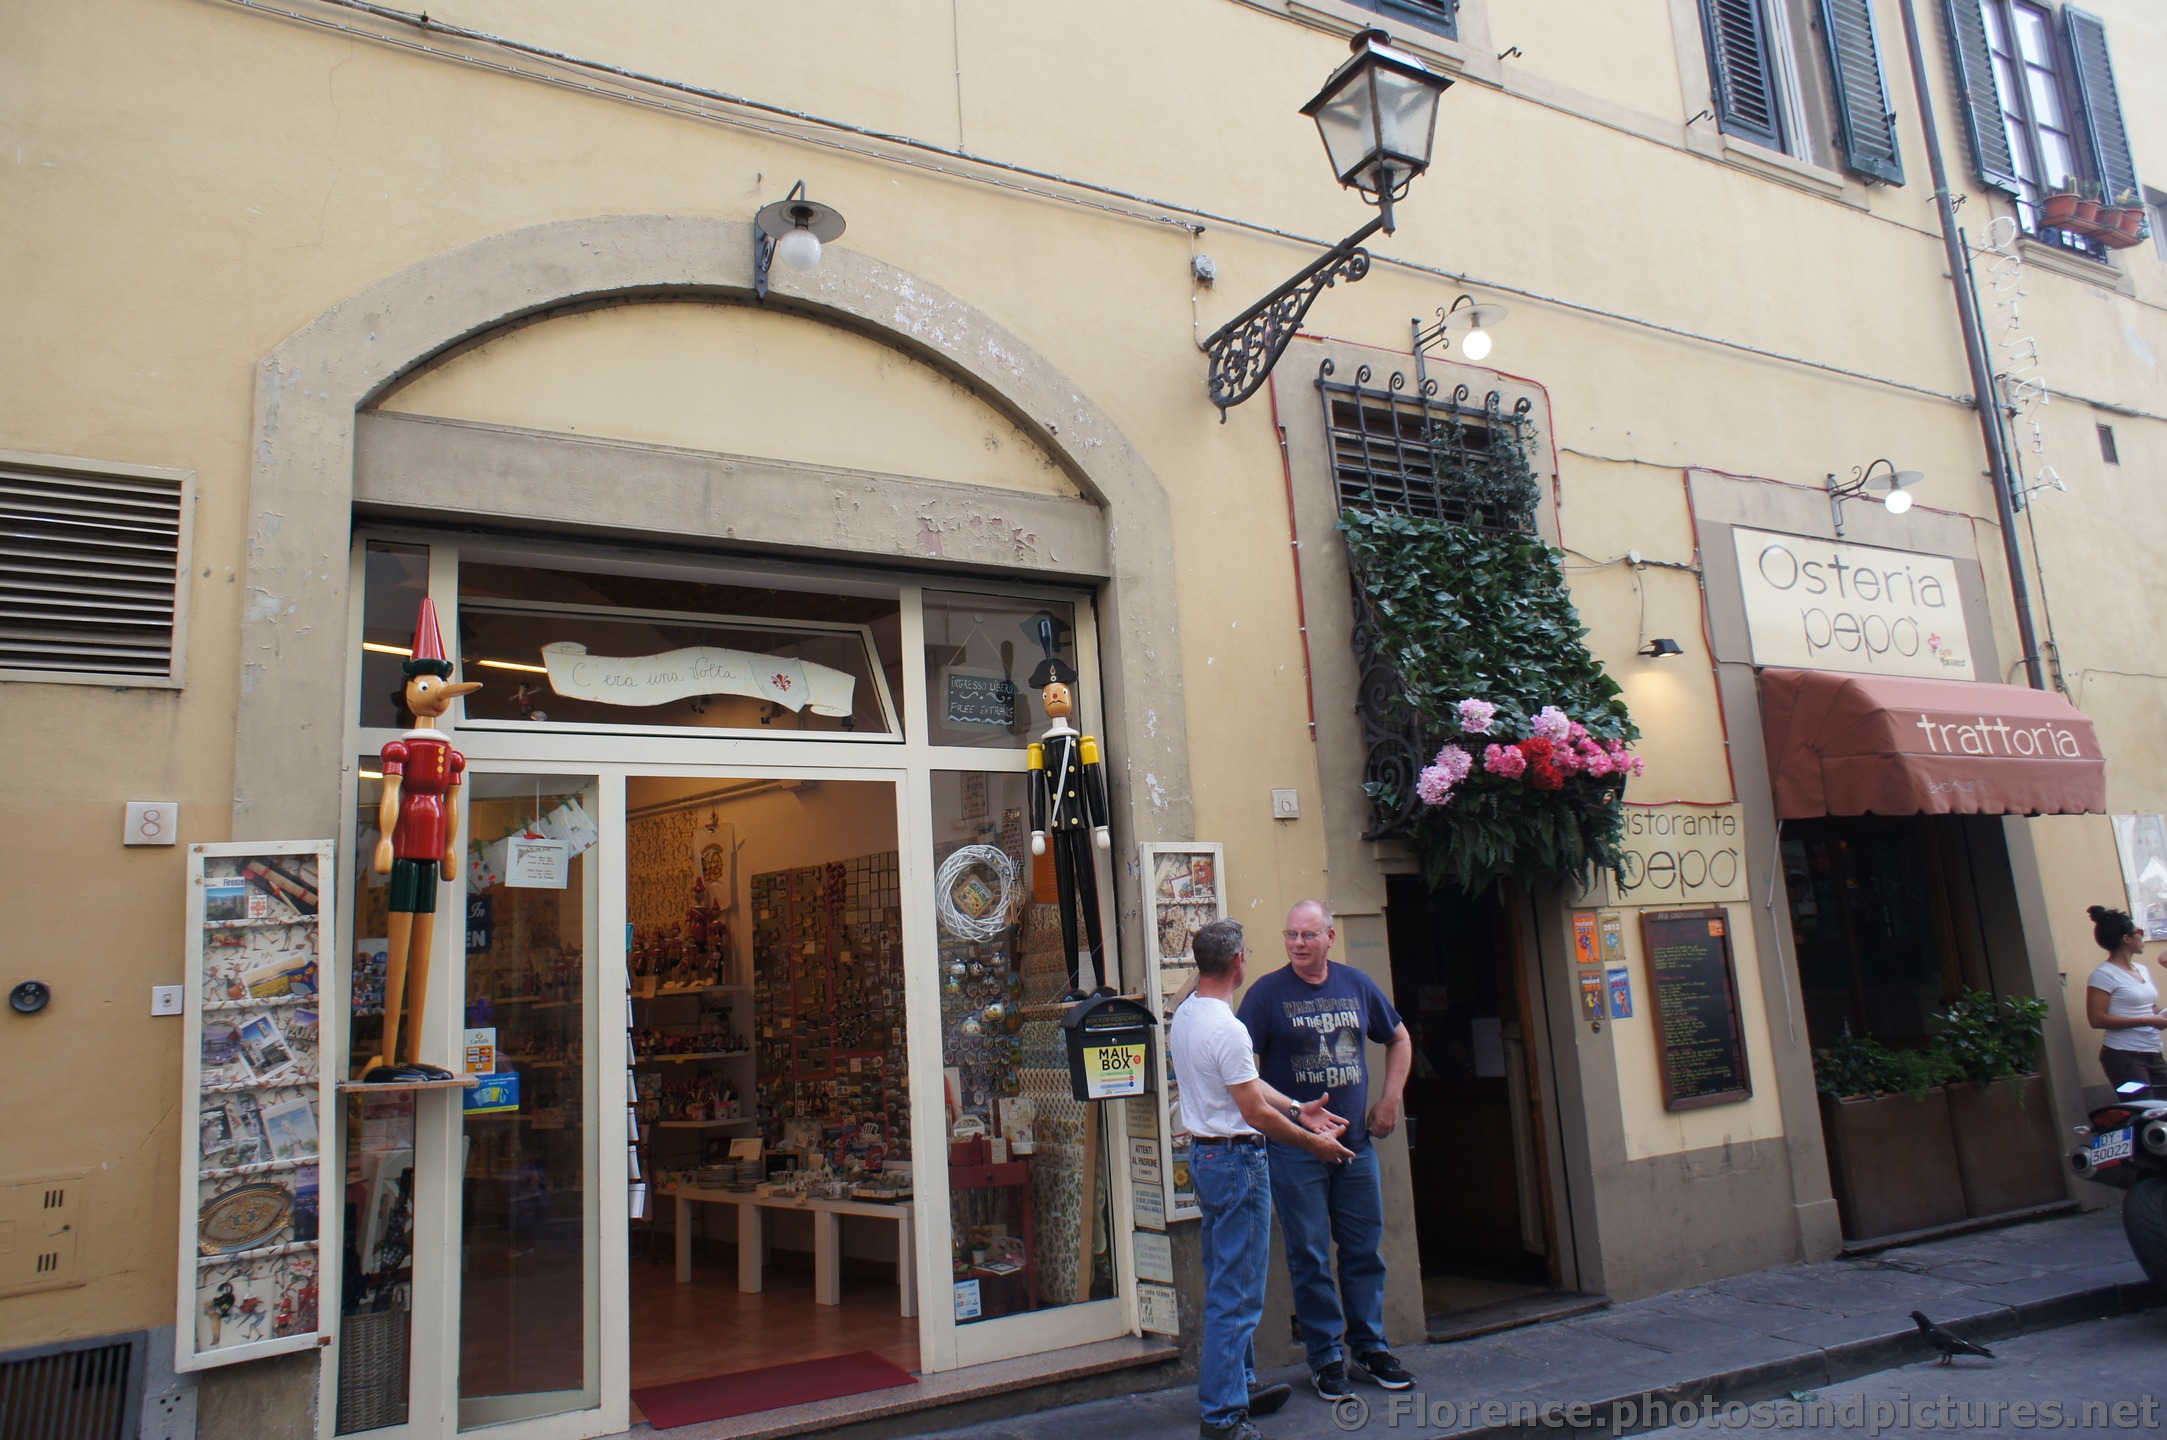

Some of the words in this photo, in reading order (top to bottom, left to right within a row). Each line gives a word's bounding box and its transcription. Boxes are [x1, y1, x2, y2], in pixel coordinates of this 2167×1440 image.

[1758, 544, 1946, 608] Osteria
[1800, 607, 1919, 663] pepò
[646, 672, 684, 686] una
[989, 680, 1014, 694] LIBERO
[949, 701, 976, 714] FREE
[979, 705, 1014, 718] ENTRANCE
[1916, 713, 2081, 758] trattoria
[1280, 798, 1292, 814] 6
[140, 809, 161, 837] 8
[1616, 847, 1738, 900] pepò
[223, 878, 245, 887] Firenze
[467, 901, 487, 919] In
[1282, 1000, 1315, 1018] WHAT
[1292, 1016, 1305, 1028] IN
[1305, 1014, 1322, 1029] THE
[1320, 1010, 1360, 1034] BARN
[1098, 1047, 1133, 1060] MAIL
[1101, 1058, 1131, 1071] BOX
[1295, 1070, 1306, 1083] IN
[1306, 1071, 1325, 1084] THE
[2101, 1132, 2116, 1146] DY
[1135, 1144, 1153, 1155] ATTENTI
[2093, 1143, 2130, 1163] 30022
[1132, 1156, 1138, 1165] AL
[1138, 1157, 1158, 1168] PADRONE
